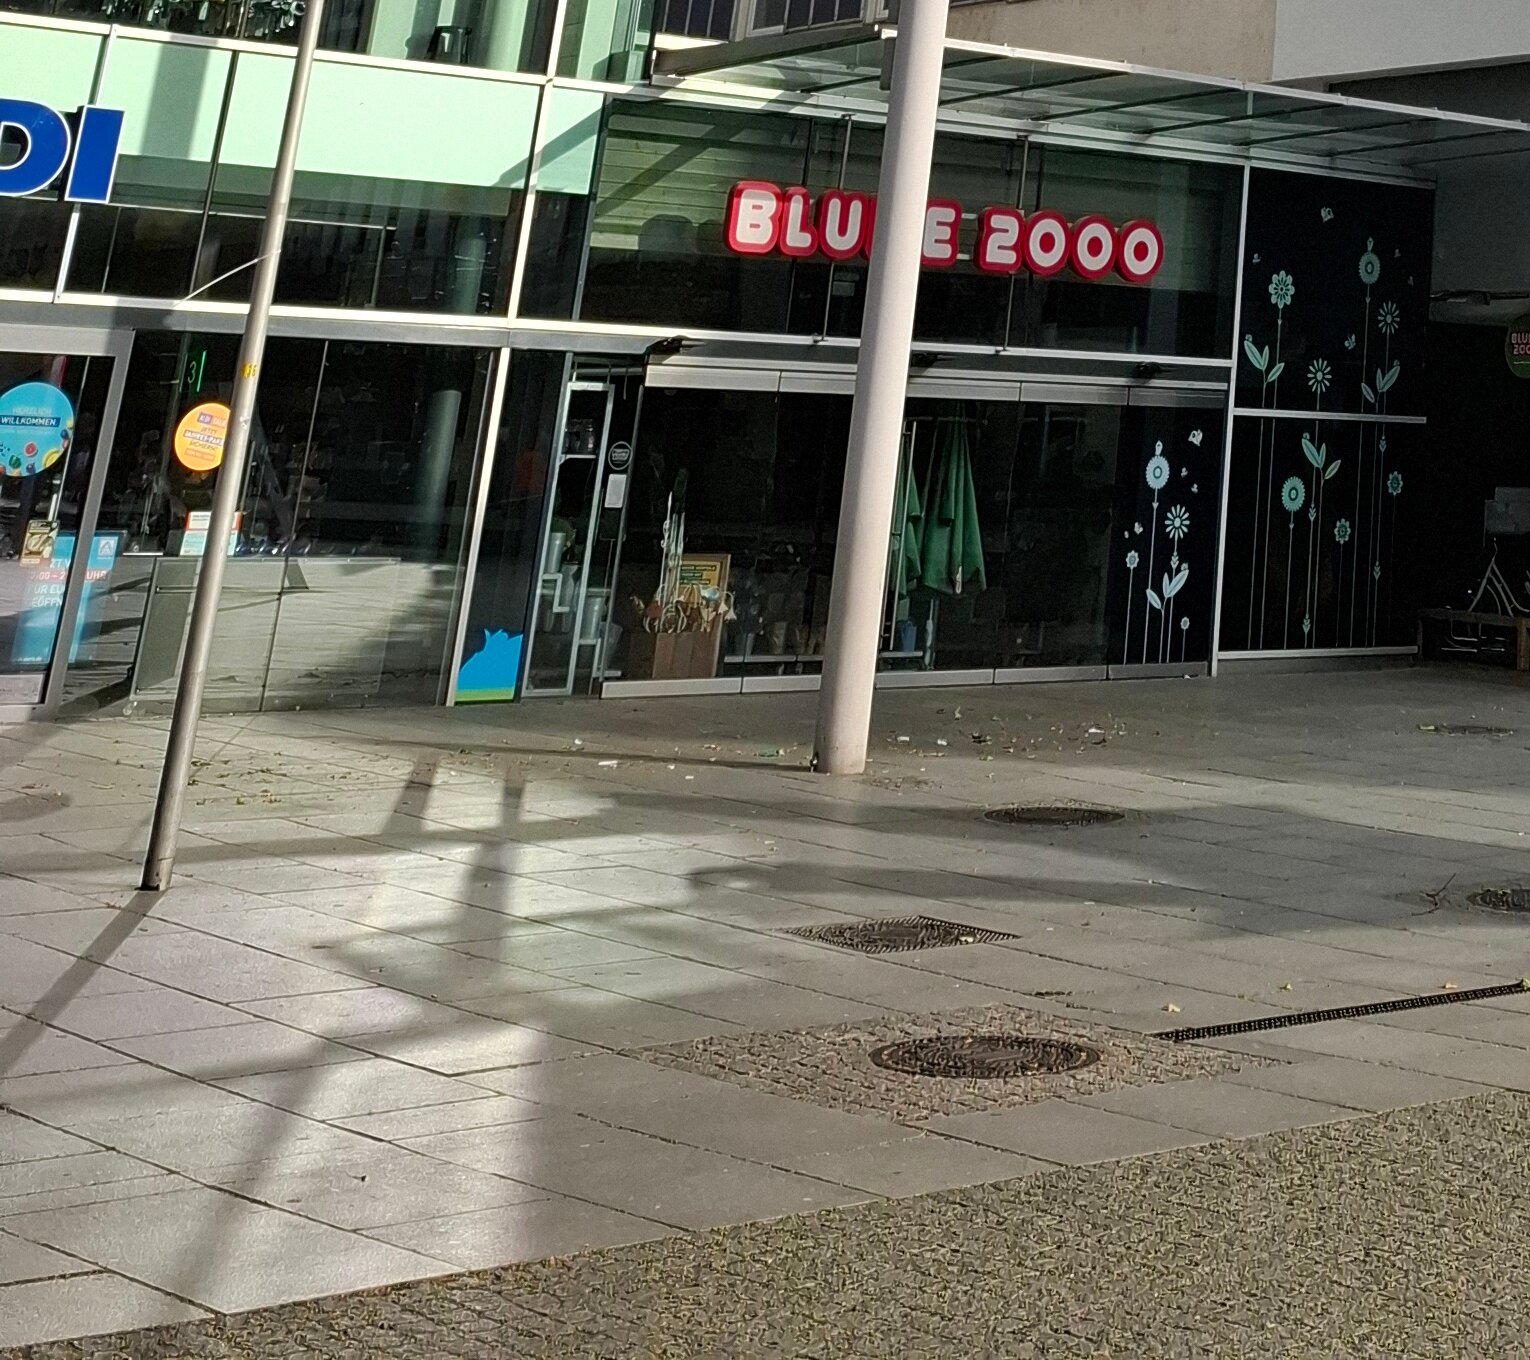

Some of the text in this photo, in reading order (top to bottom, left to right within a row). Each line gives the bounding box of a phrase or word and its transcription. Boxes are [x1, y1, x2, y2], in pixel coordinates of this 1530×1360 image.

[727, 182, 1162, 280] BLUE 2000
[1, 416, 57, 426] WILLKOMMEN
